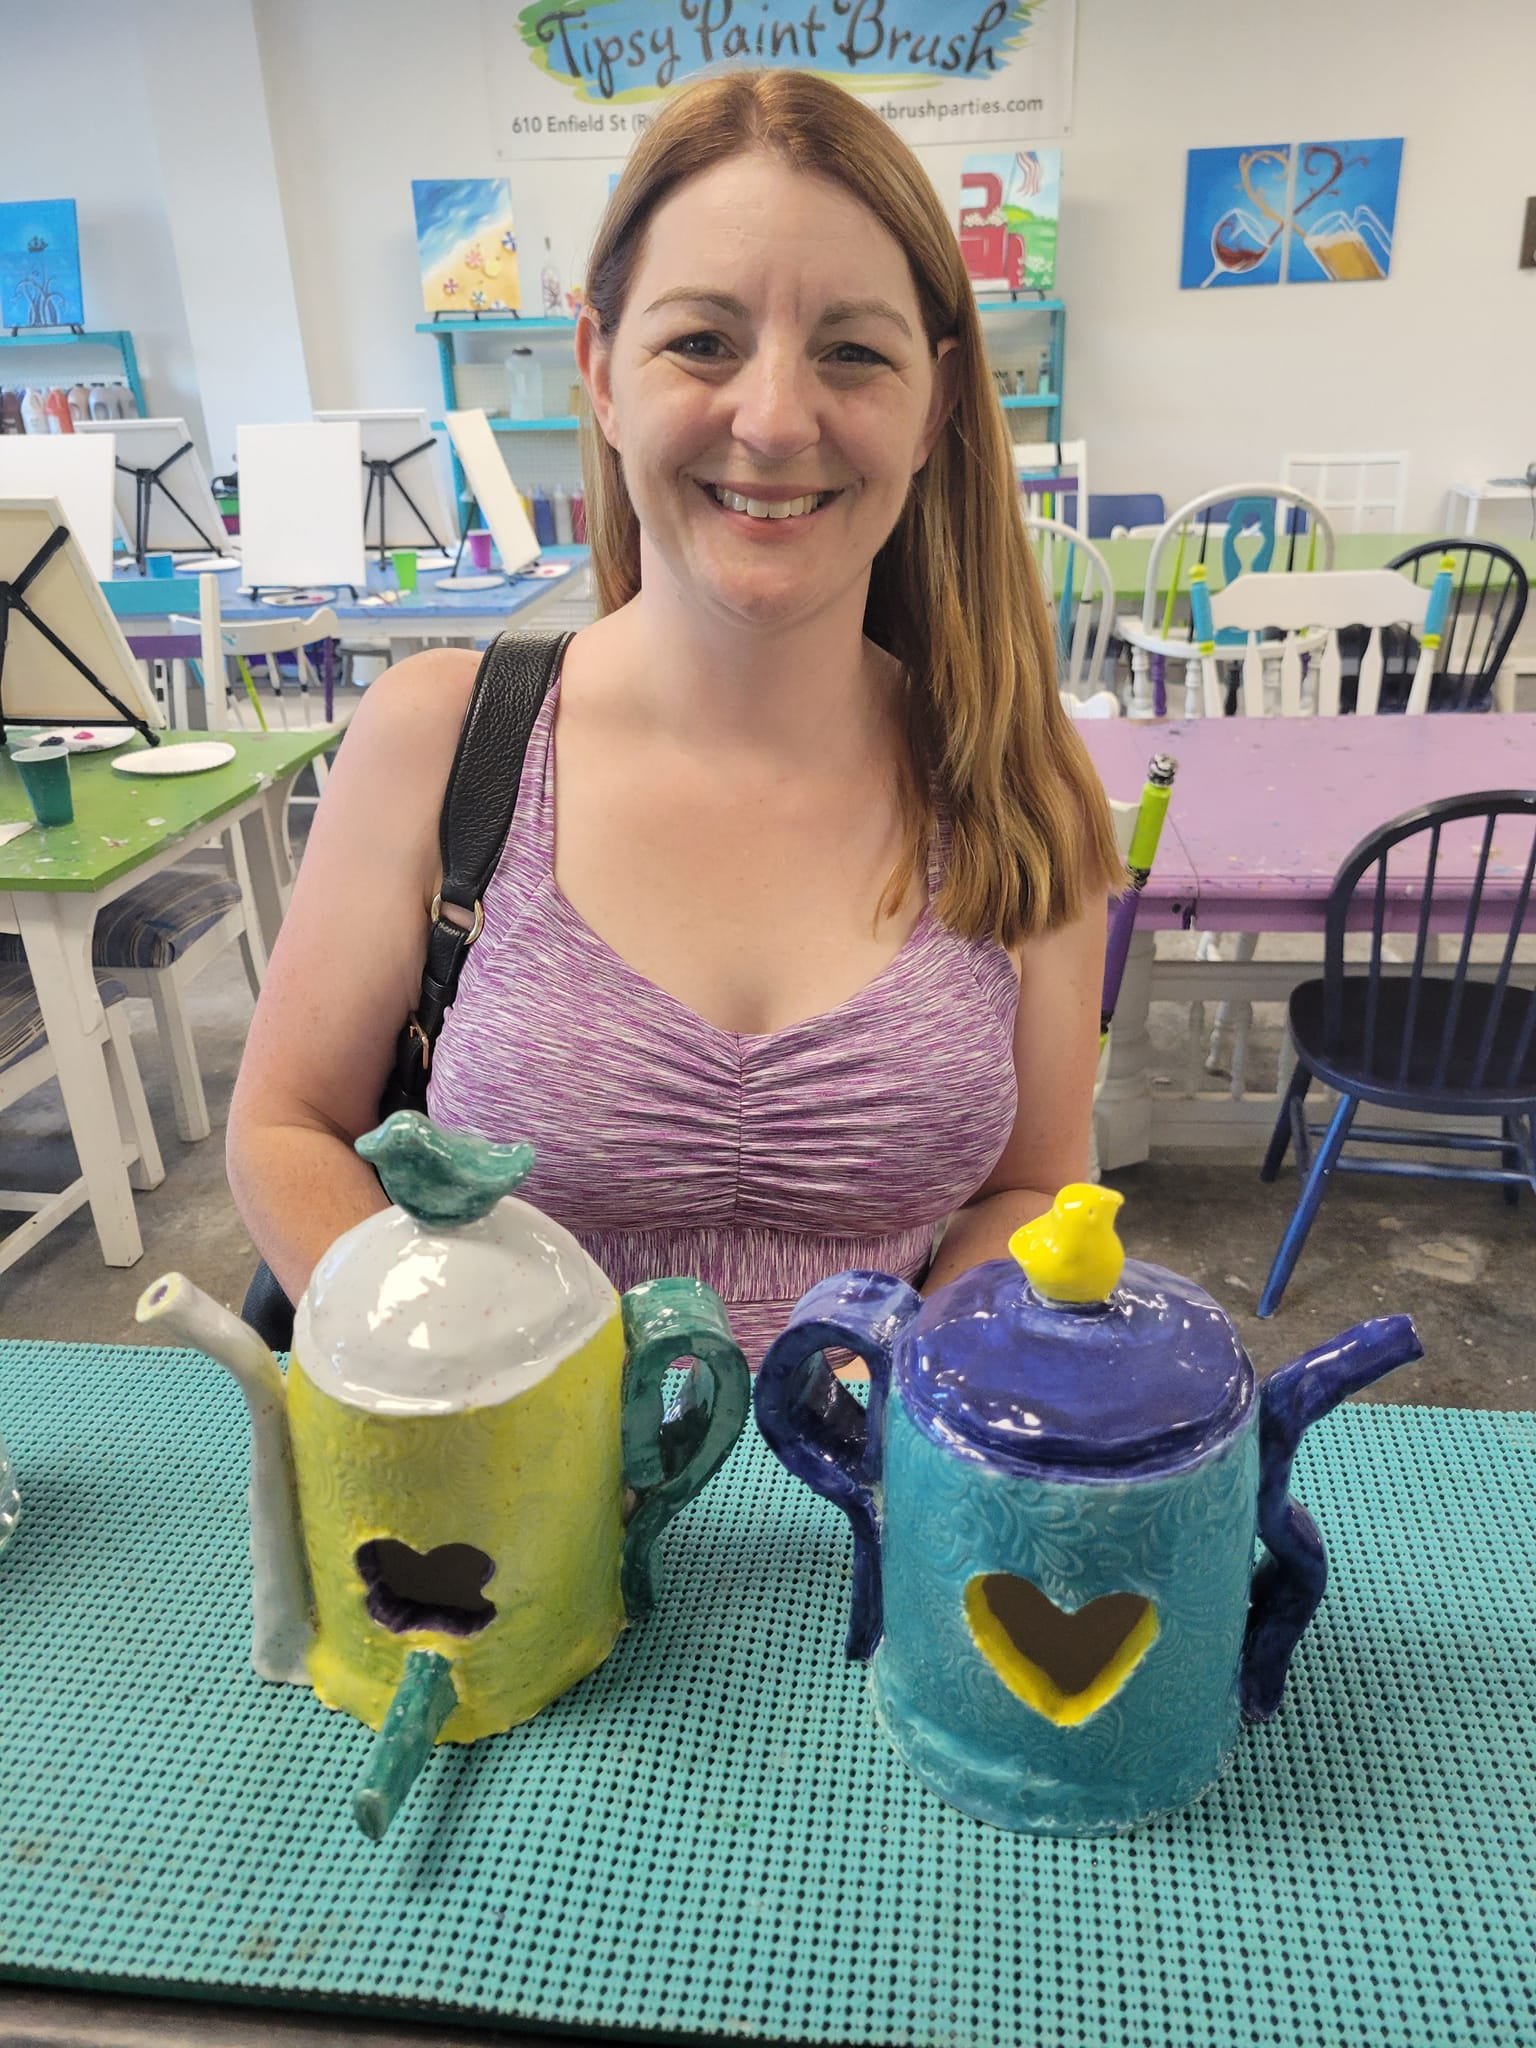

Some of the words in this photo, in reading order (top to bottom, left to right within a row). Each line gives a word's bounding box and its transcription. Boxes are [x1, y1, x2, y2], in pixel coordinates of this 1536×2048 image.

[536, 9, 681, 100] Tipsy
[680, 0, 825, 62] Paint
[832, 0, 1007, 73] Brush
[512, 115, 542, 134] 610
[547, 114, 604, 133] Enfield
[609, 114, 626, 132] St
[878, 98, 1043, 121] tbrushparties.com
